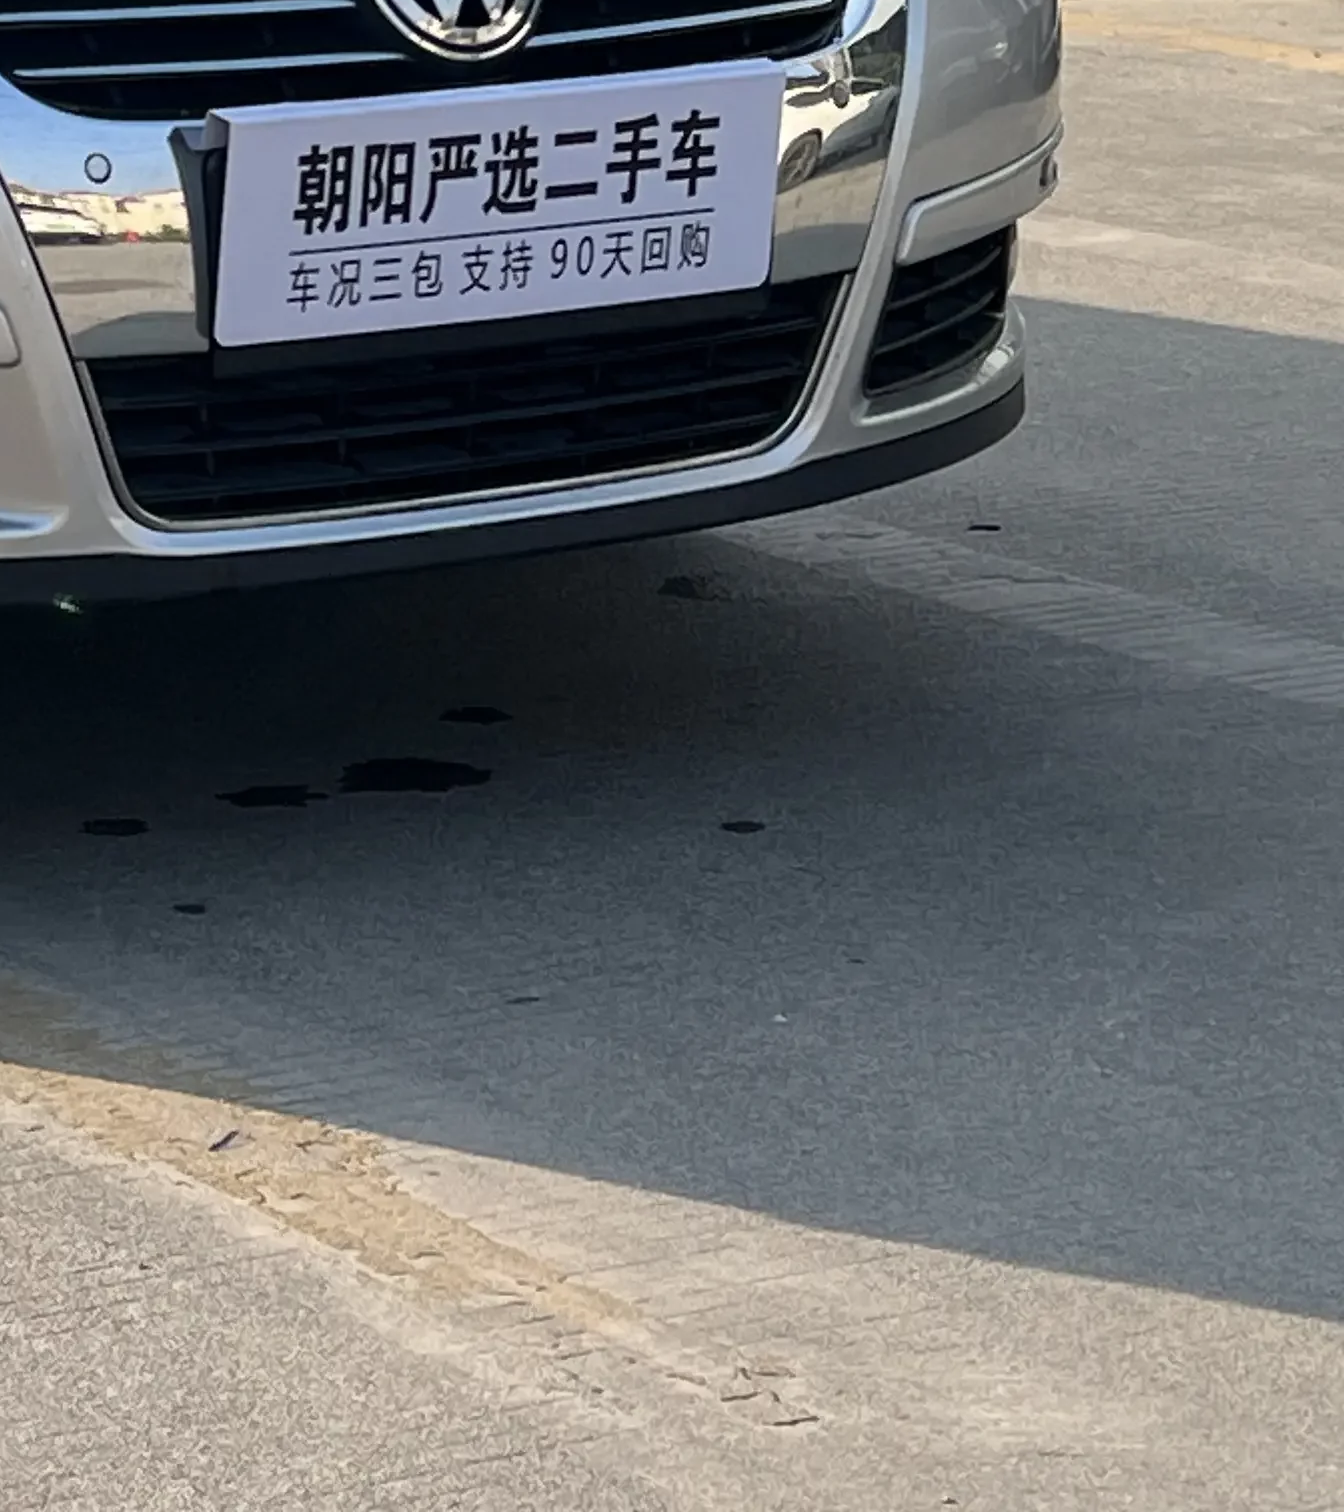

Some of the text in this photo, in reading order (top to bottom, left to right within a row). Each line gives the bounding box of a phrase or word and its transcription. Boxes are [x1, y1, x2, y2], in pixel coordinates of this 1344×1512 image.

[293, 109, 721, 236] 朝阳严选二手车
[285, 220, 711, 314] 车况三包 支持 90天回购
